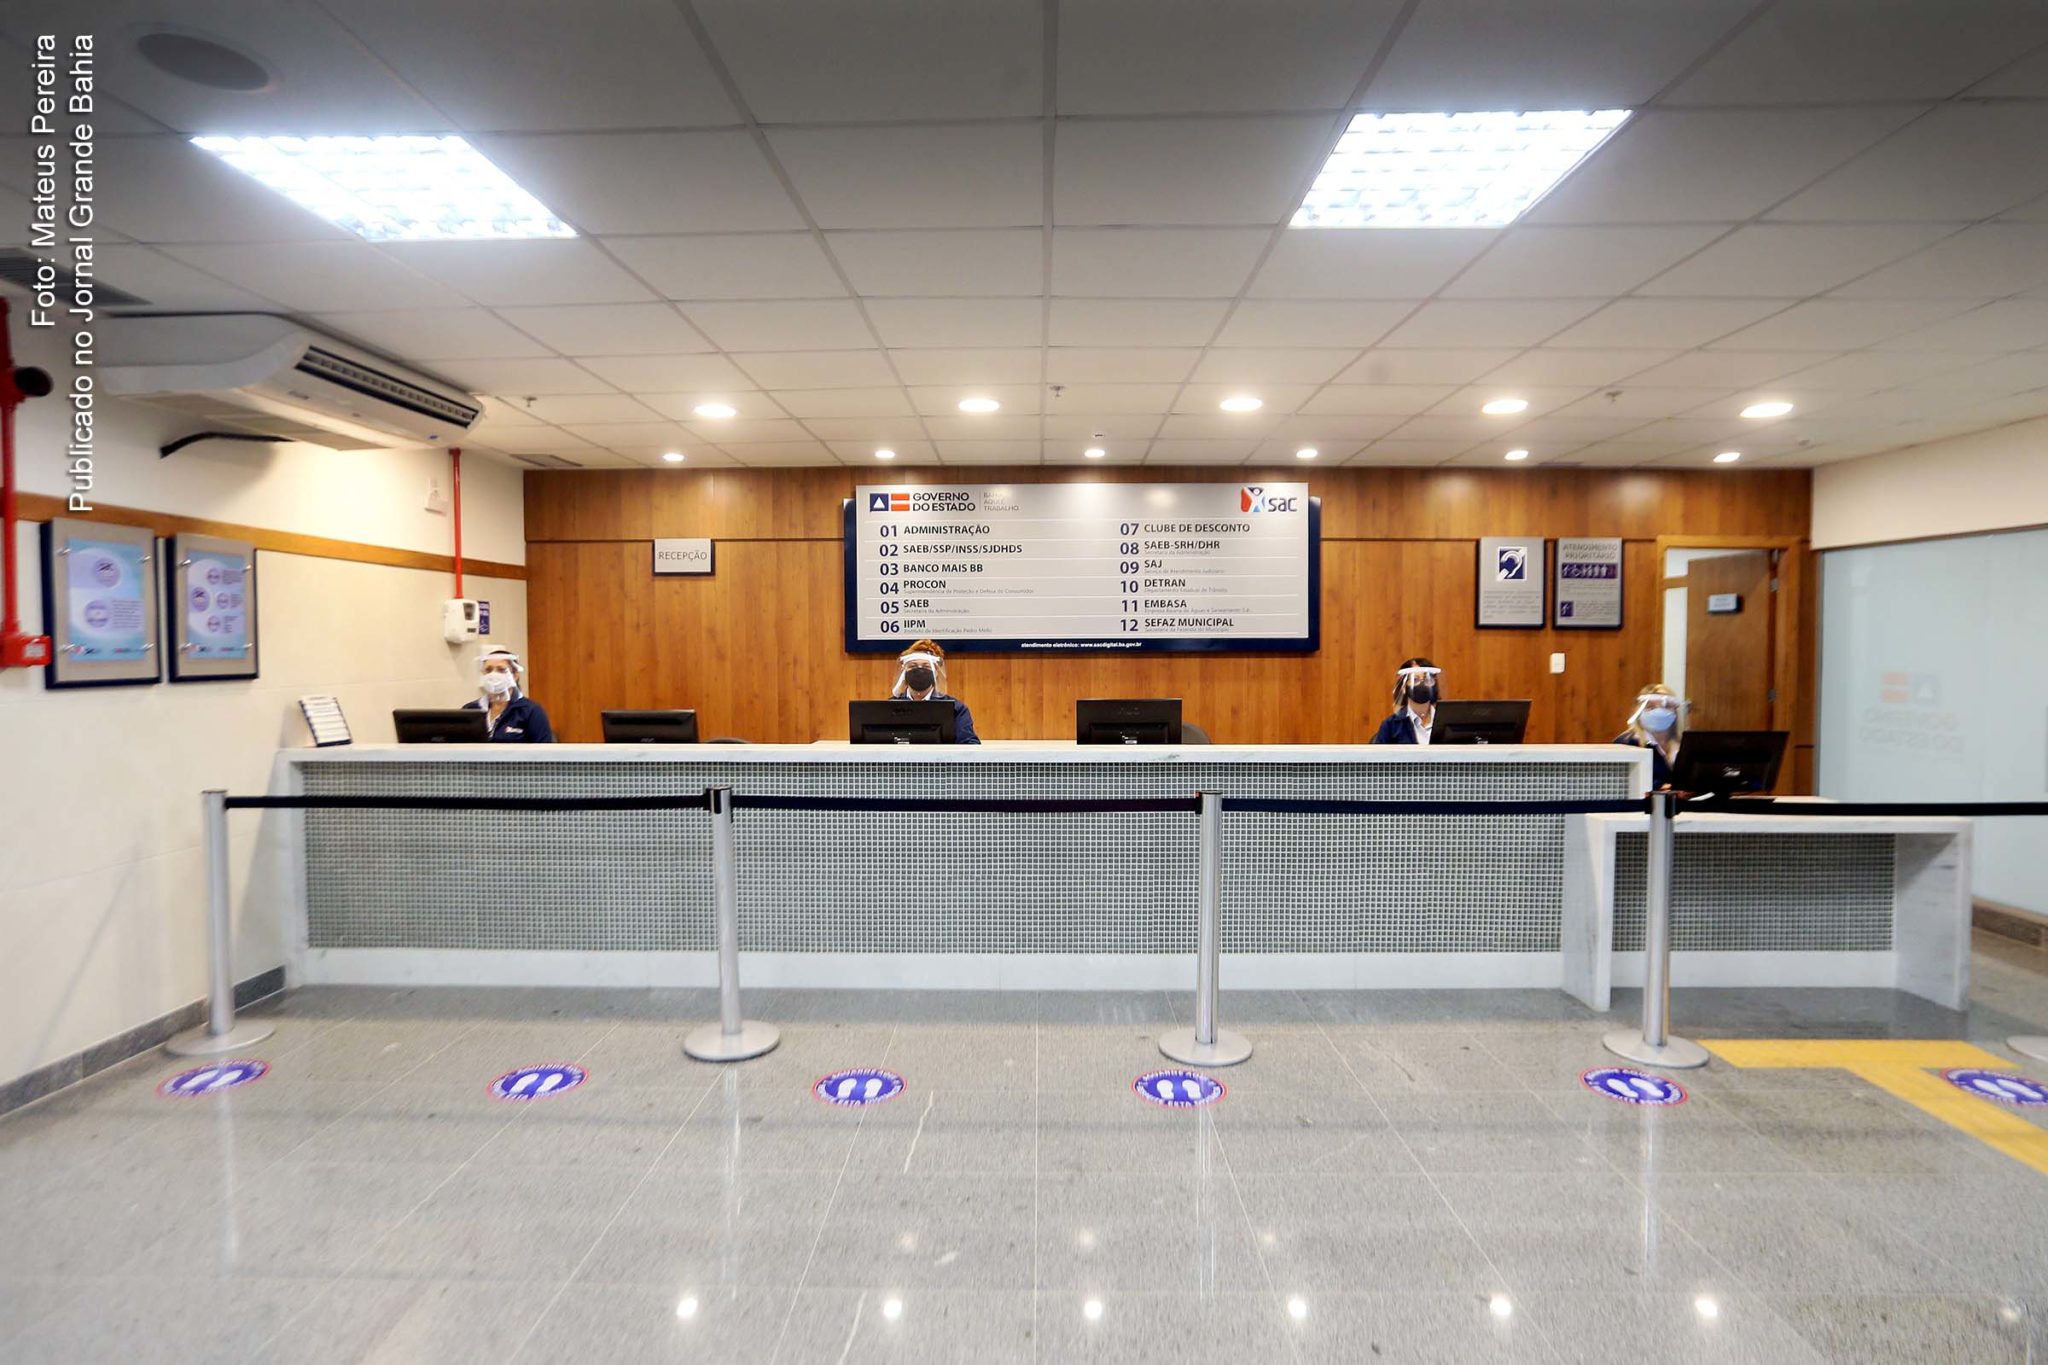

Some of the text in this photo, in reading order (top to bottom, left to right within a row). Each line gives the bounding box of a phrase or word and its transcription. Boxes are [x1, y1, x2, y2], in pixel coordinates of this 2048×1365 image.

[913, 492, 969, 501] GOVERNO
[913, 502, 975, 511] DO ESTADO
[1268, 498, 1297, 512] sac
[880, 524, 990, 537] 01 ADMINISTRAÇÃO
[1120, 523, 1250, 535] 07 CLUBE DE DESCONTO
[880, 544, 1022, 556] 02 SAEB/SSP/INSS/SJDHDS
[1120, 541, 1220, 554] 08 SAEB-SRH/DHR
[1563, 543, 1618, 551] ATENDIMENTO
[658, 549, 708, 562] RECEPÇÃO
[880, 563, 983, 575] 03 BANCO MAIS BB
[1120, 560, 1162, 574] 09 SAJ
[880, 580, 946, 594] 04 PROCON
[1120, 579, 1186, 593] 10 DETRAN
[881, 599, 929, 614] 05 SAEB
[1122, 600, 1187, 612] 11 EMBASA
[881, 620, 926, 633] 06 IIPM
[1120, 618, 1234, 632] 12 SEFAZ MUNICIPAL
